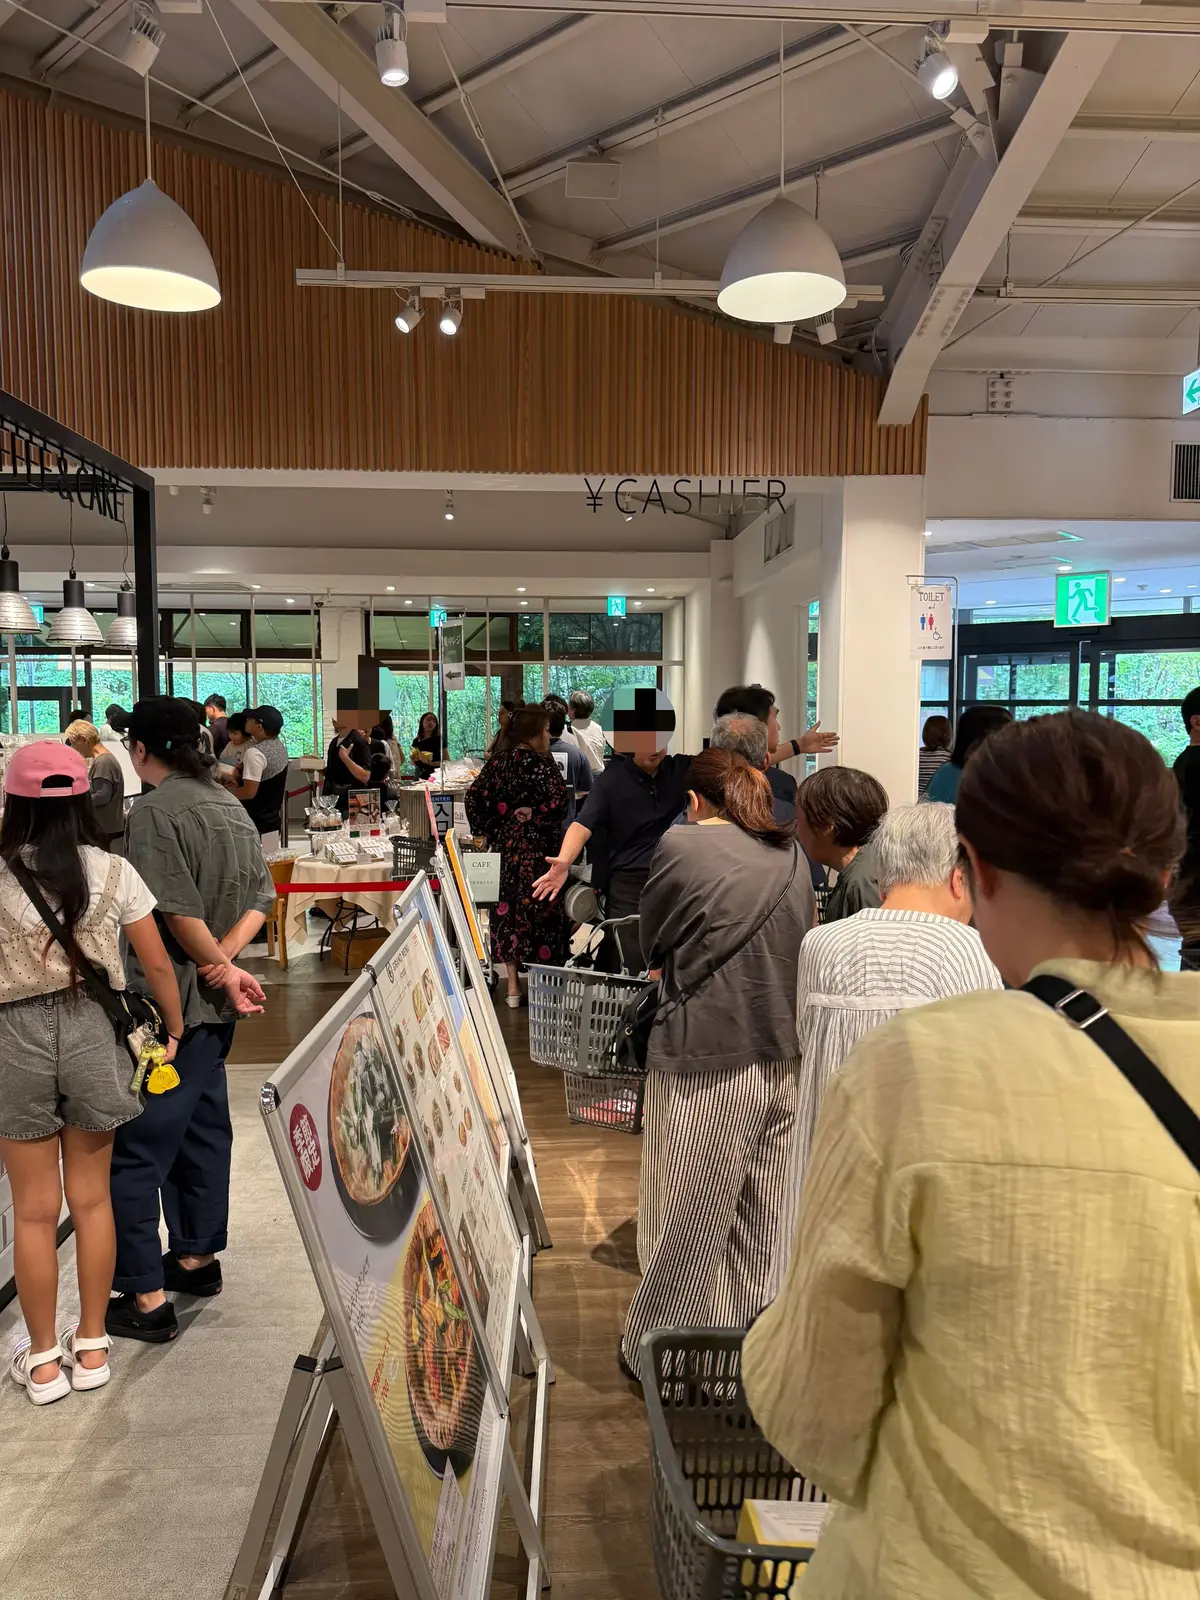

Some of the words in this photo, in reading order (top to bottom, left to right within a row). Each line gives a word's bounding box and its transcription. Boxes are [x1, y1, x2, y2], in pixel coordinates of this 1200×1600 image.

[919, 592, 945, 602] TOILET
[434, 803, 450, 834] 入口
[293, 1113, 313, 1154] 季節
[300, 1138, 320, 1182] 限定
